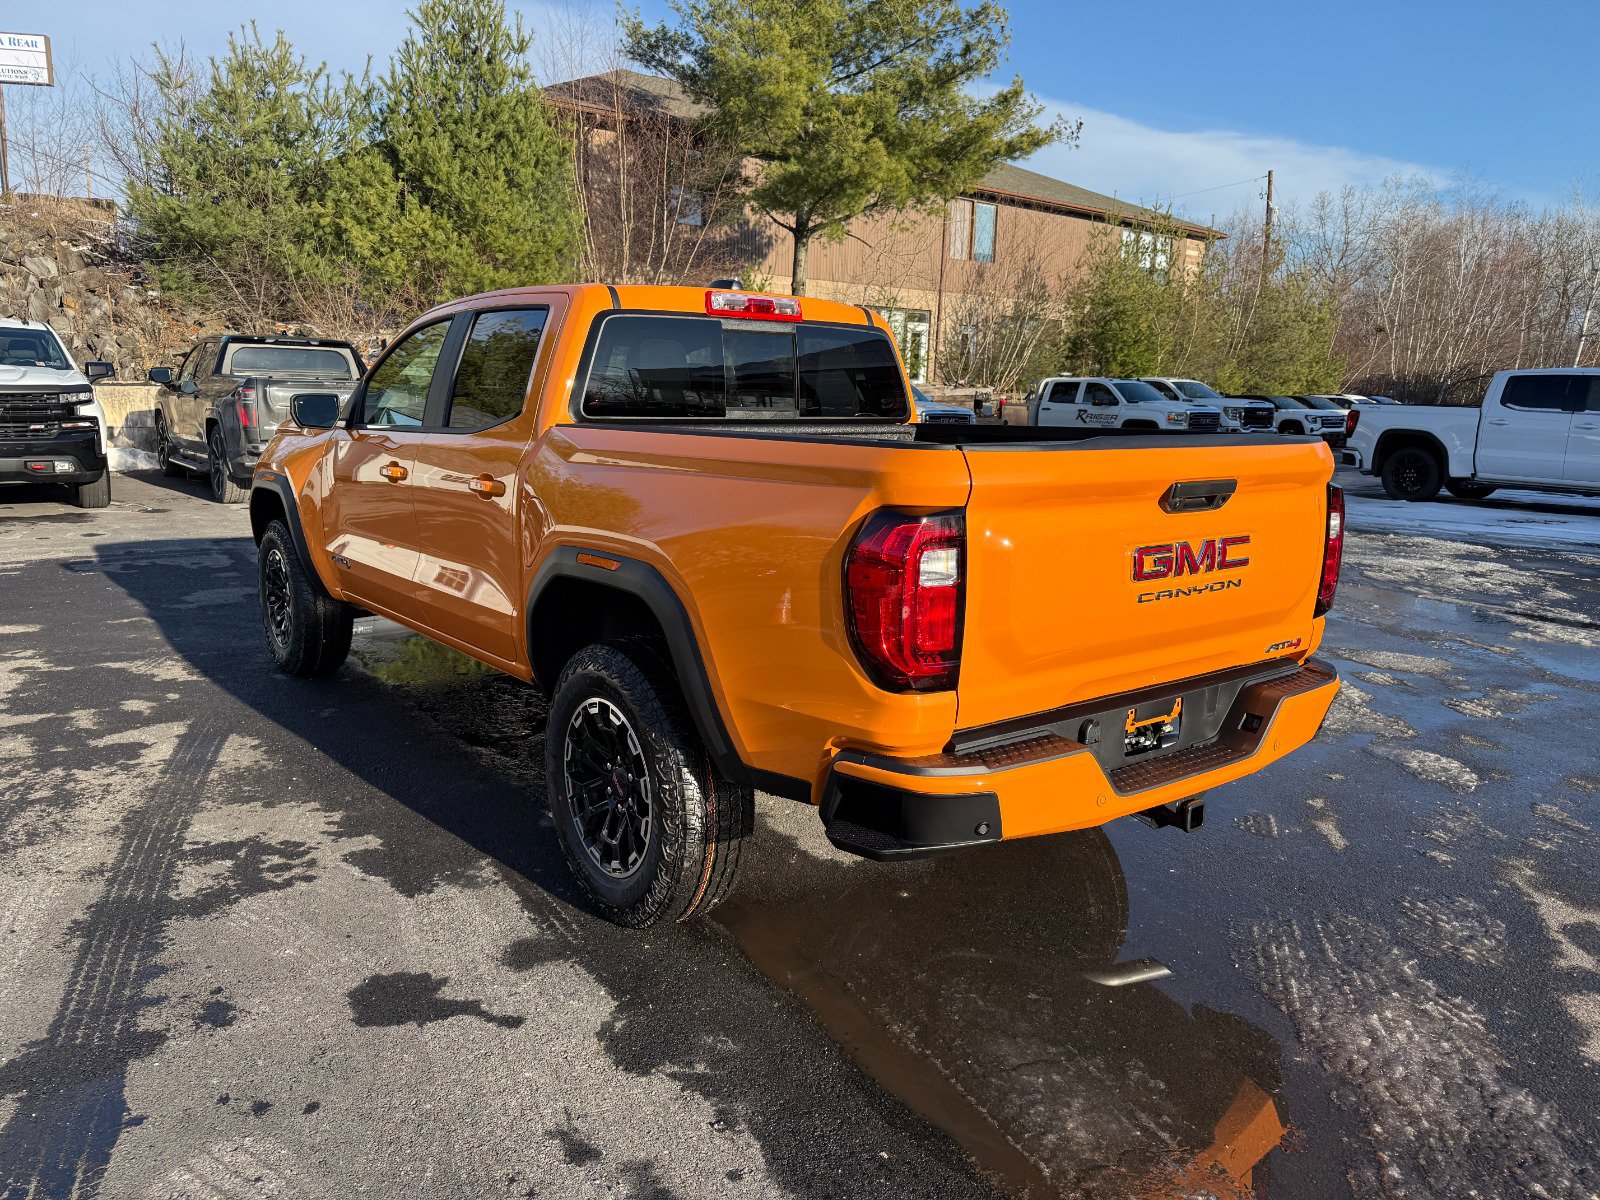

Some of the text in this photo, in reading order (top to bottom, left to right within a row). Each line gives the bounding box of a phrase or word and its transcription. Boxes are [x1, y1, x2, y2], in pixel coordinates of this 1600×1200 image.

[1132, 535, 1250, 583] GMC
[1137, 578, 1242, 604] CANYON
[1265, 637, 1301, 654] AT4
